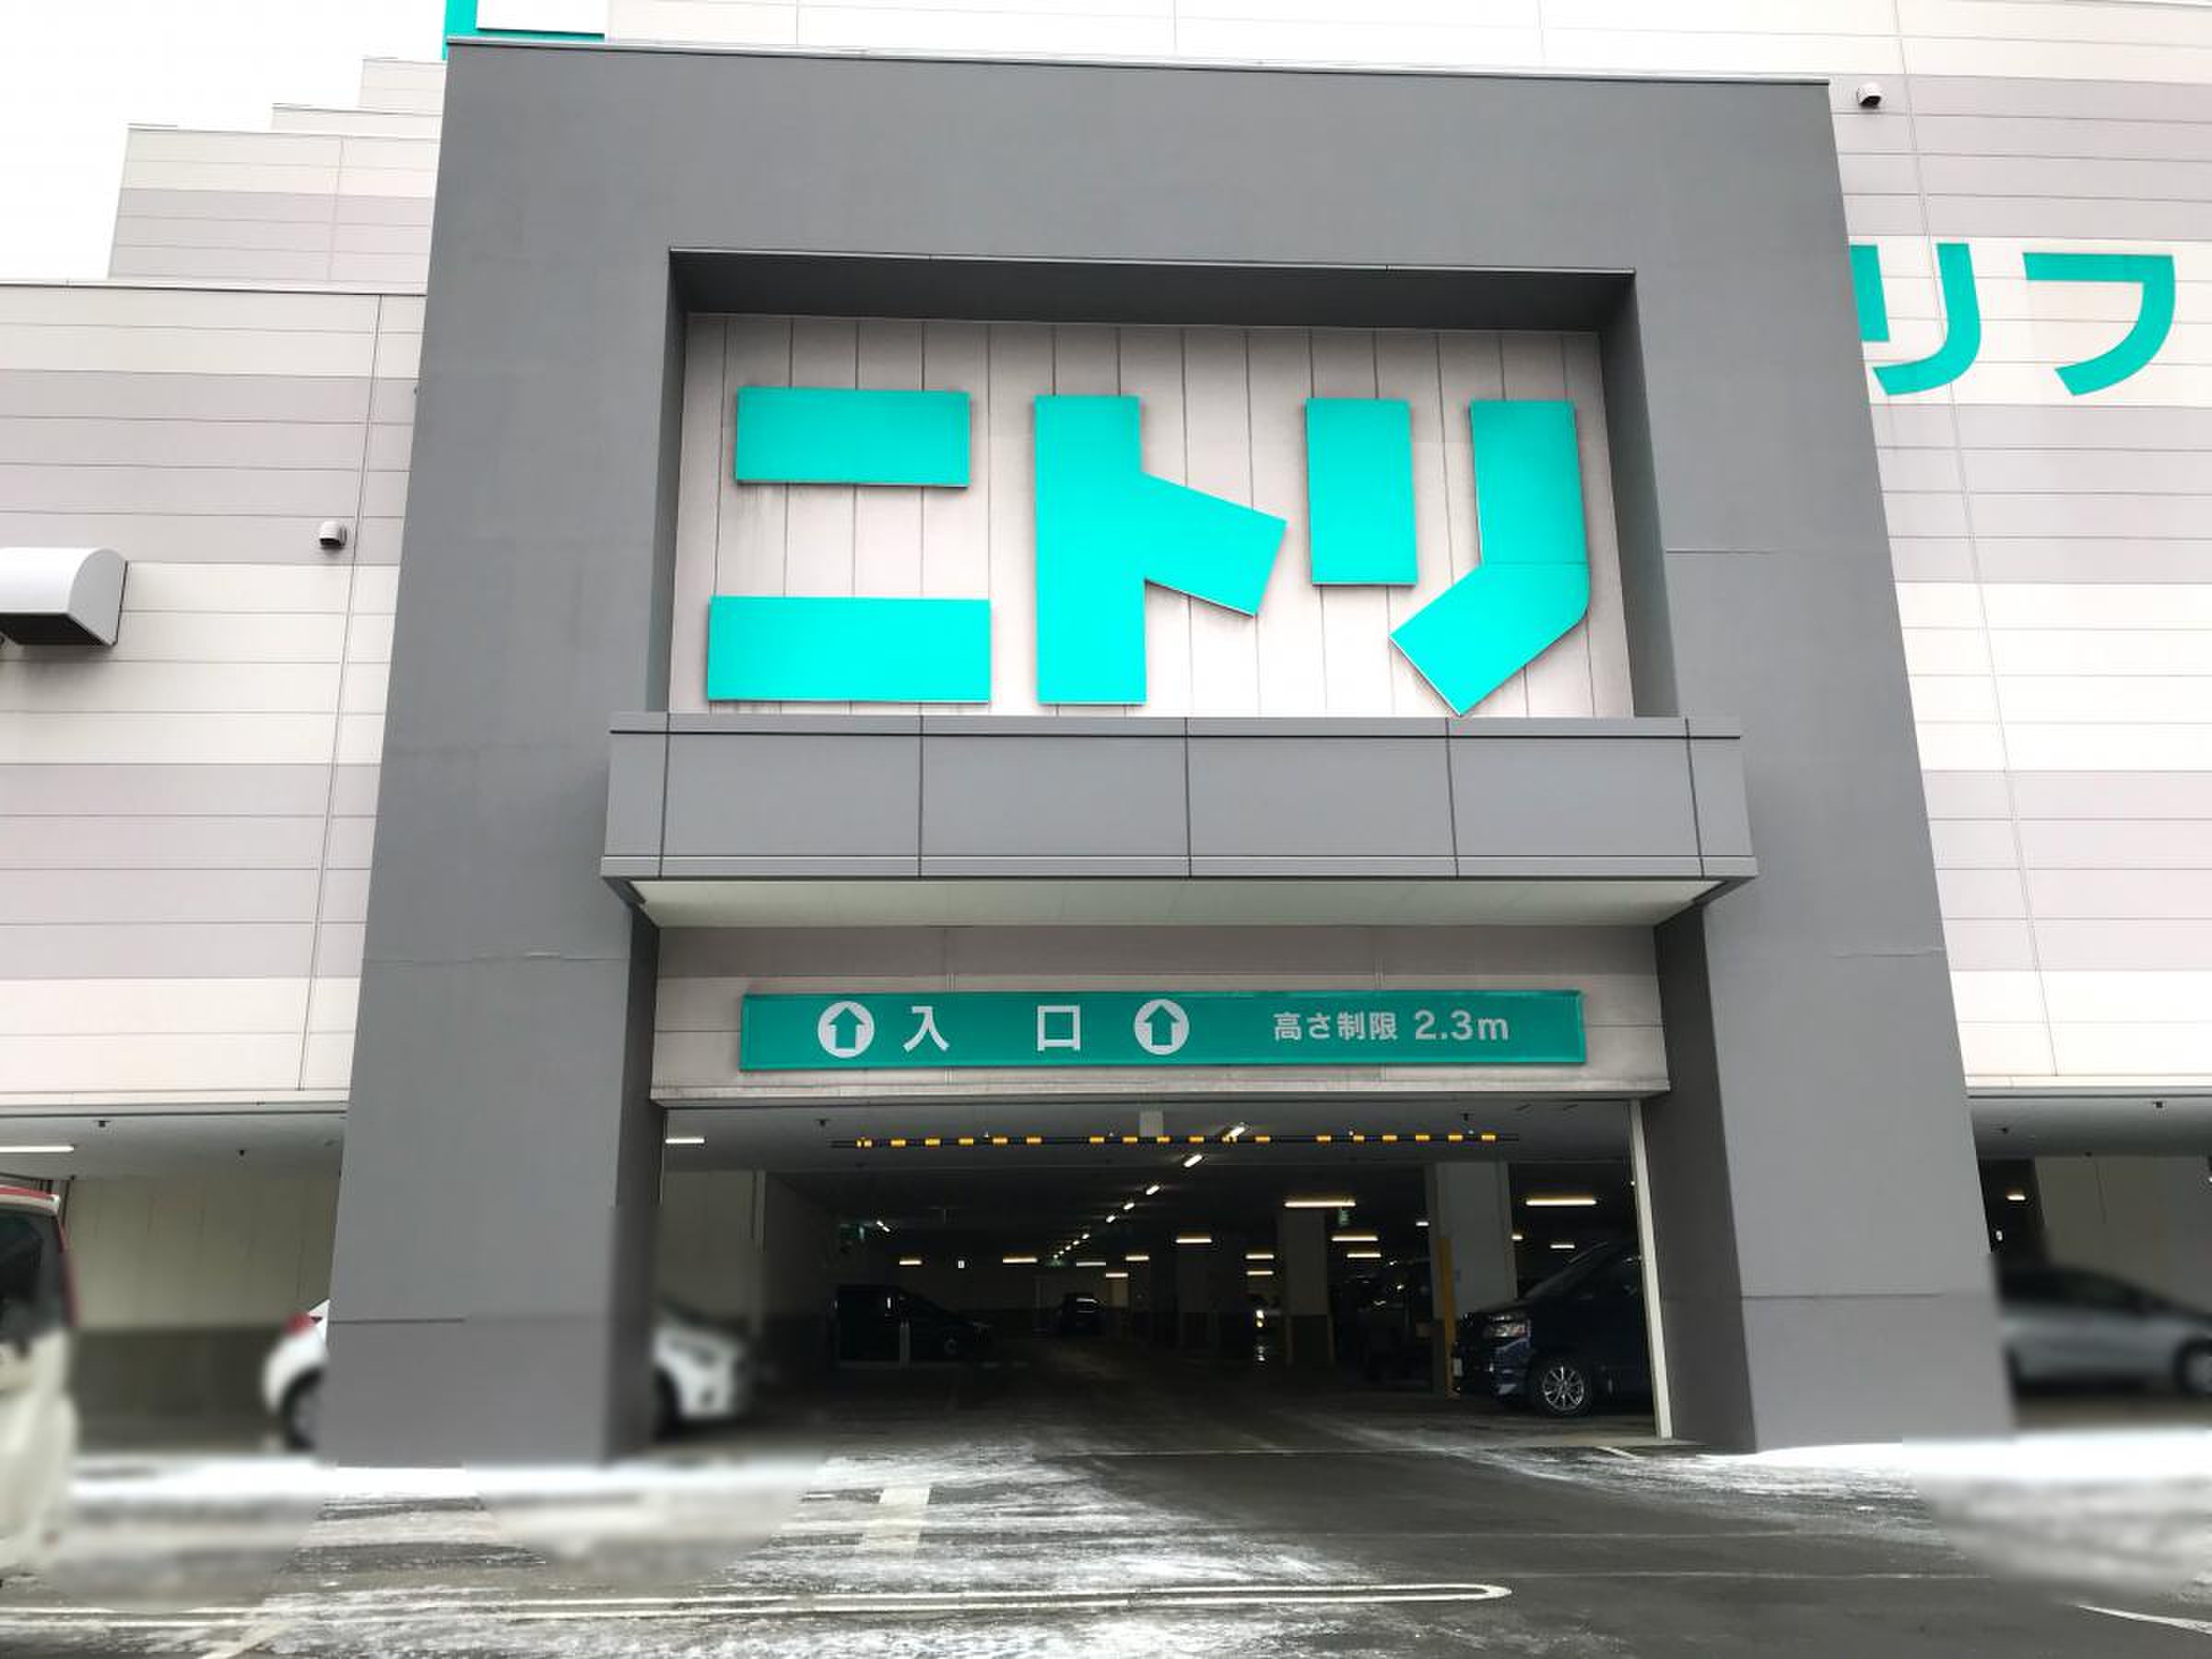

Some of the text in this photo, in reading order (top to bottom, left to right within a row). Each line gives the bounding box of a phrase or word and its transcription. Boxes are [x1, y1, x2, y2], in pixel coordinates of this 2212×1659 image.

[1849, 241, 2176, 396] リフ
[707, 385, 1591, 715] ニトリ
[902, 1006, 1082, 1052] 入口
[1273, 1010, 1509, 1041] 高さ制限 2.3m
